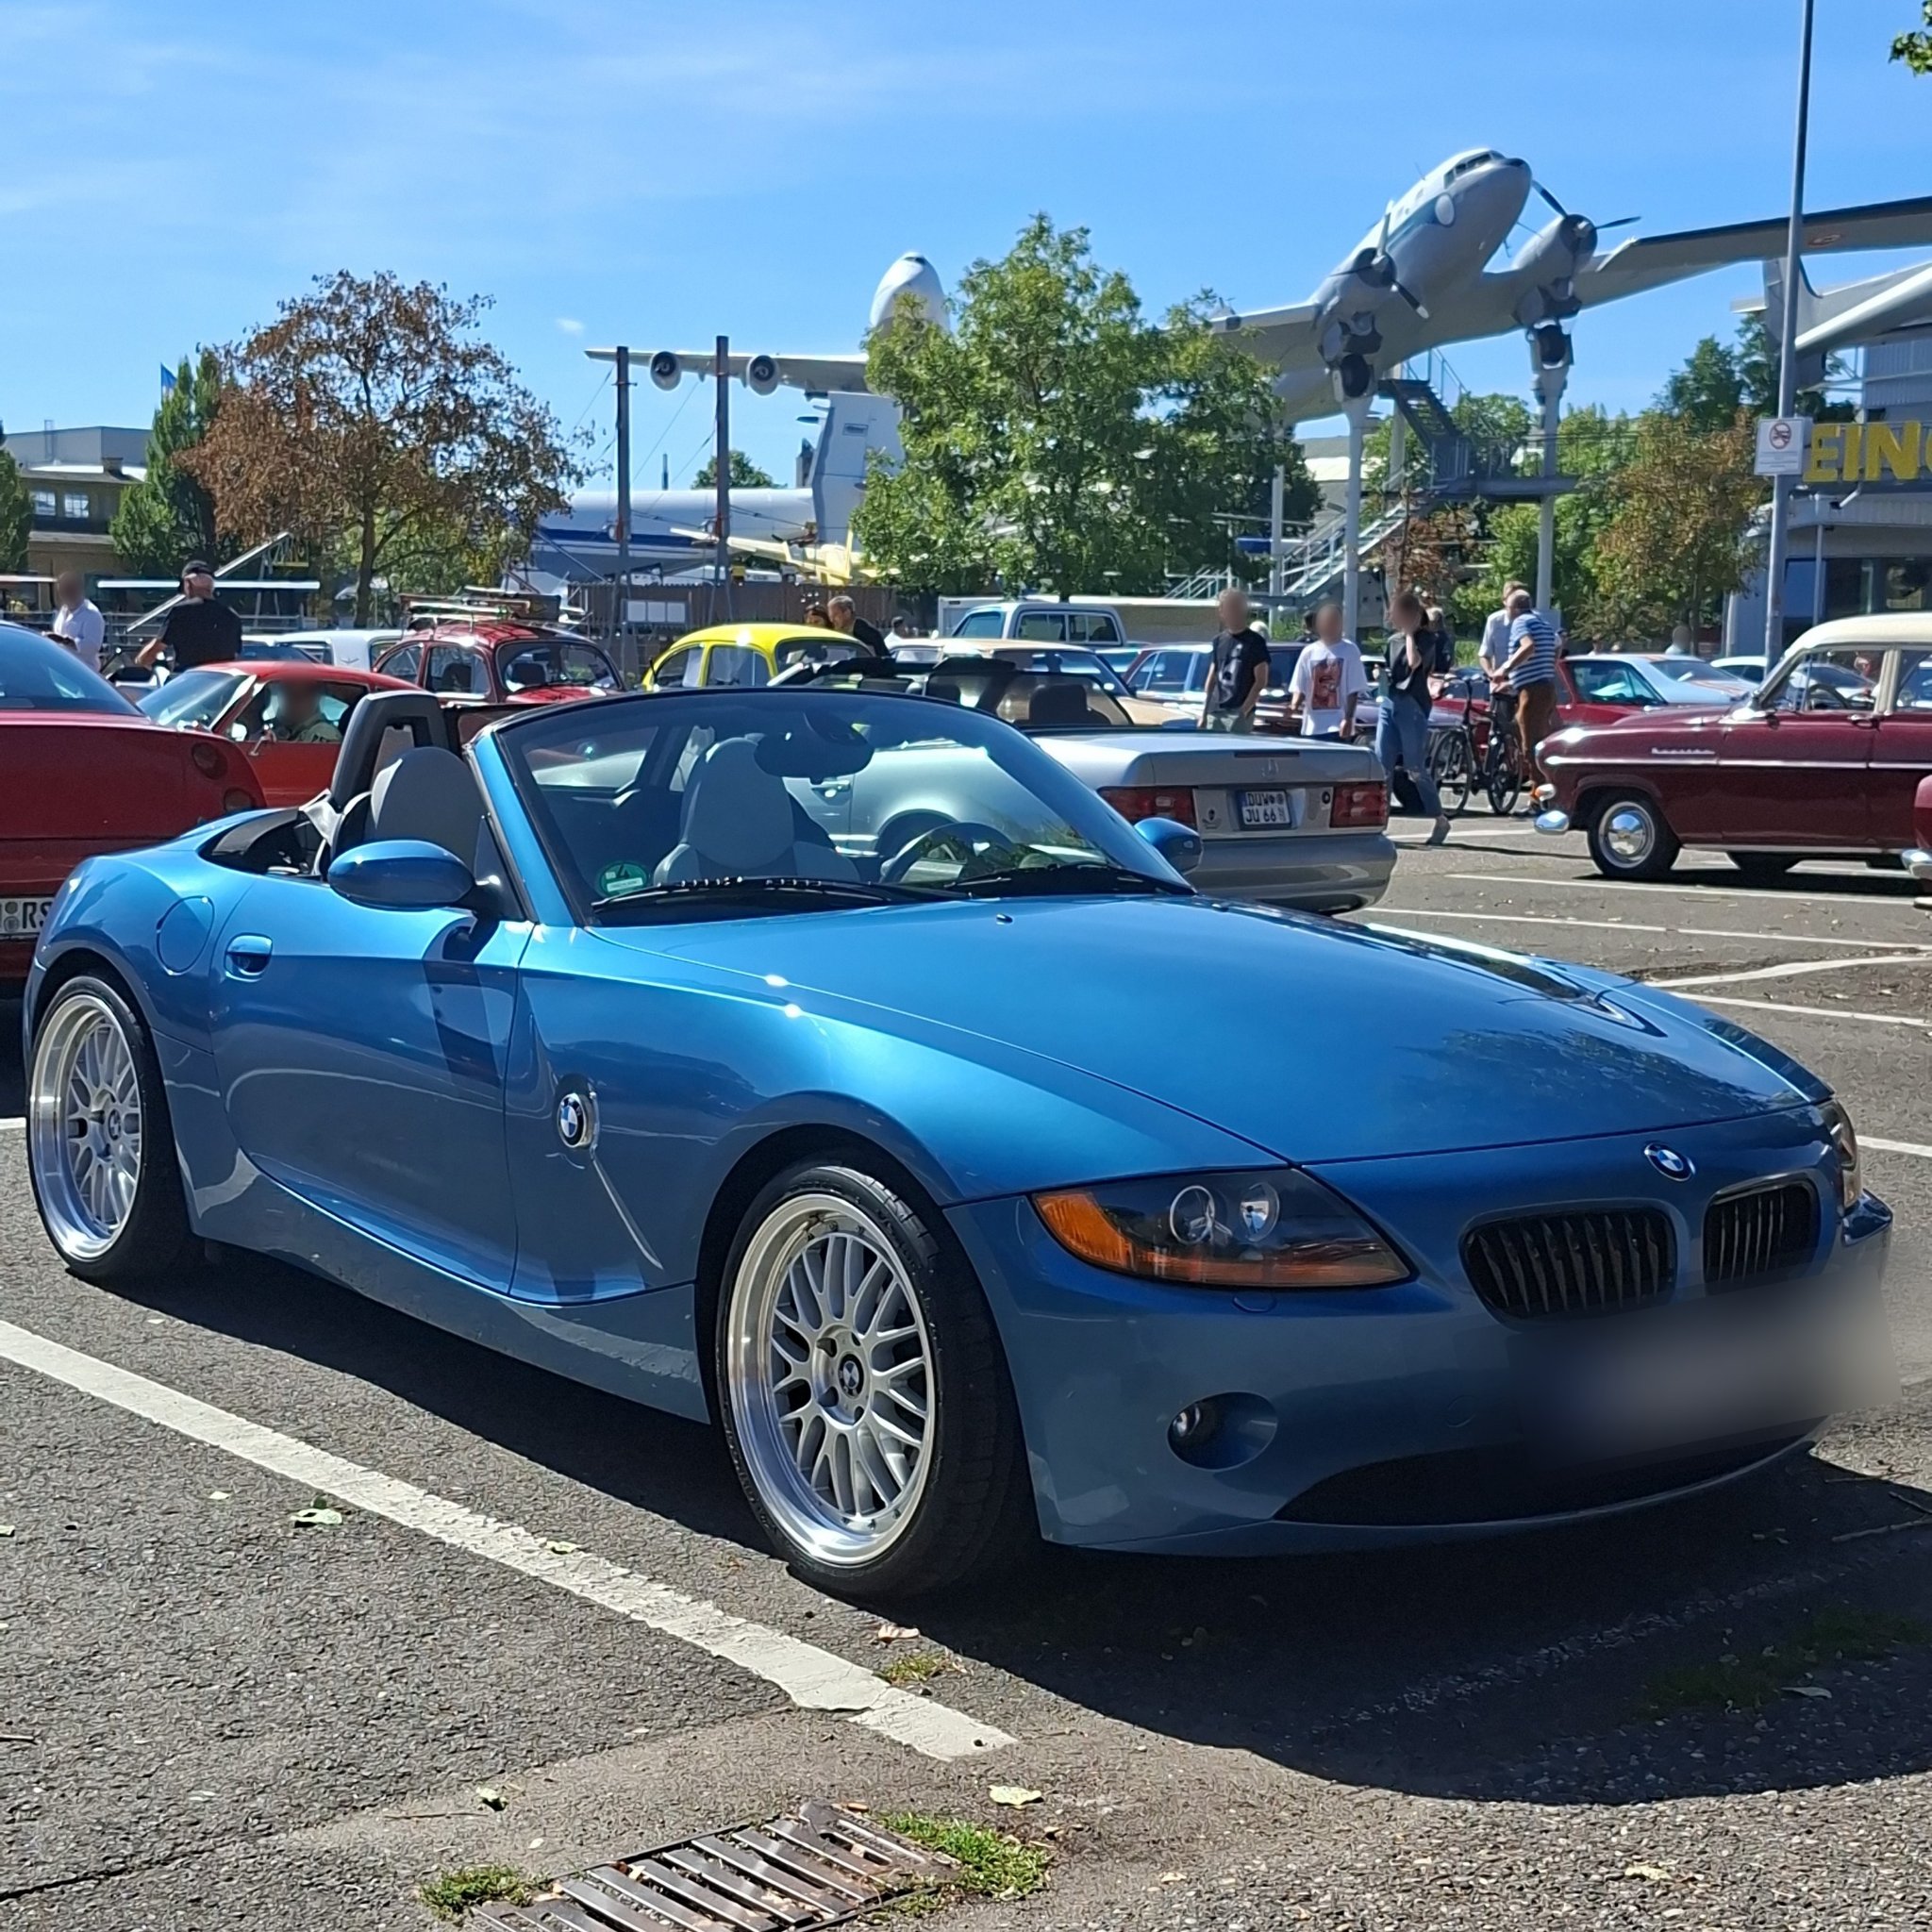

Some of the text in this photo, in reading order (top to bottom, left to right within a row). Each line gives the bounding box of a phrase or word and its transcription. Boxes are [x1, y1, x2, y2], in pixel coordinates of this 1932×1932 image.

[1803, 420, 1932, 482] EIN
[1245, 808, 1276, 823] JU 66
